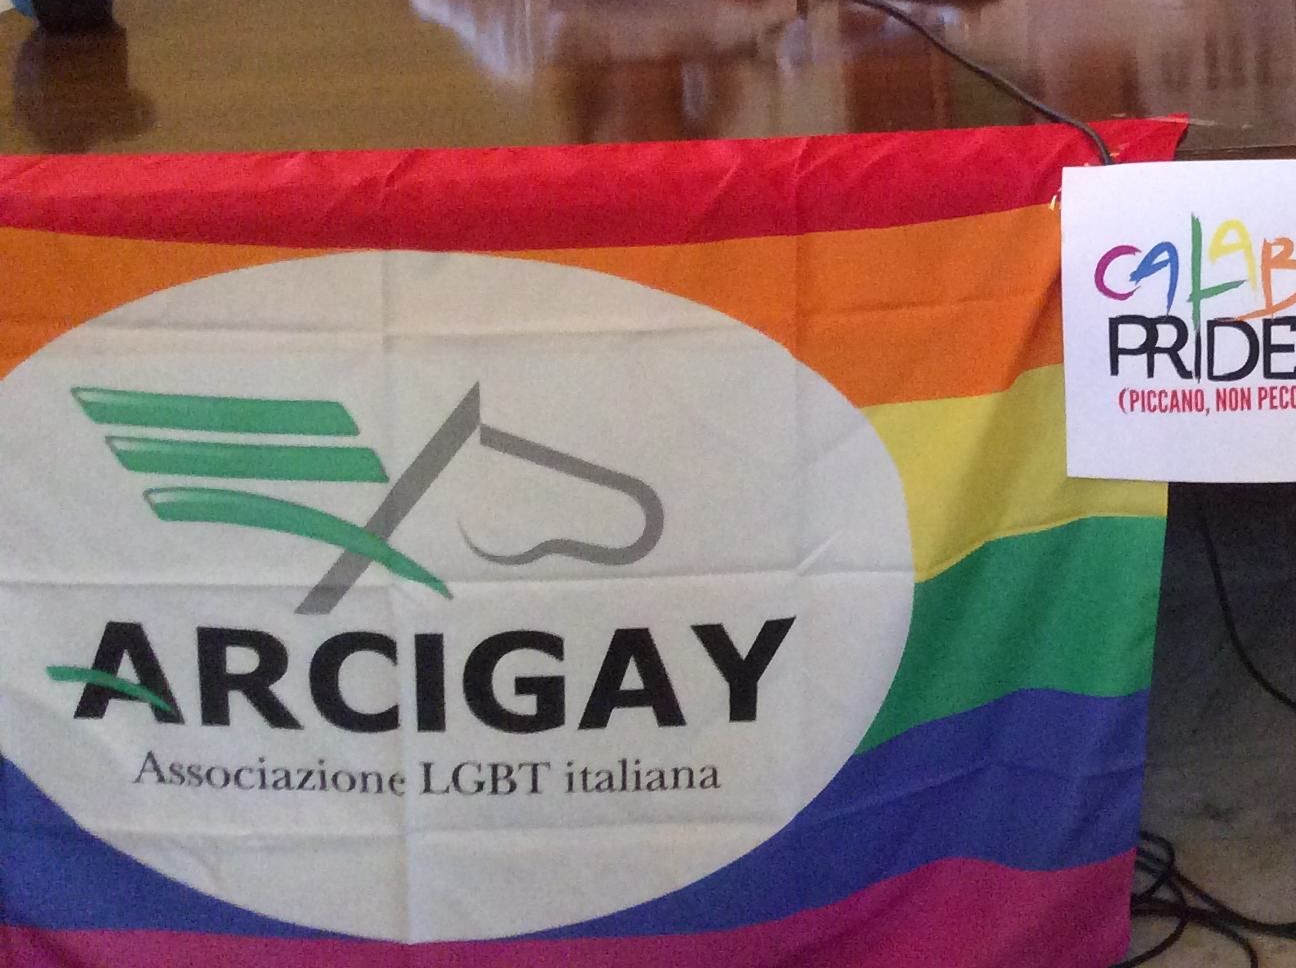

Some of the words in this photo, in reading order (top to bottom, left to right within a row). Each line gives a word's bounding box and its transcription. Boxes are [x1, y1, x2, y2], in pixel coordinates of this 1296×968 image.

[1118, 388, 1210, 416] (PICCANO,
[1215, 386, 1251, 412] NON
[46, 616, 797, 734] ARCIGAY
[133, 748, 407, 798] Associazione
[422, 760, 552, 798] LGBT
[565, 754, 722, 793] italiana
